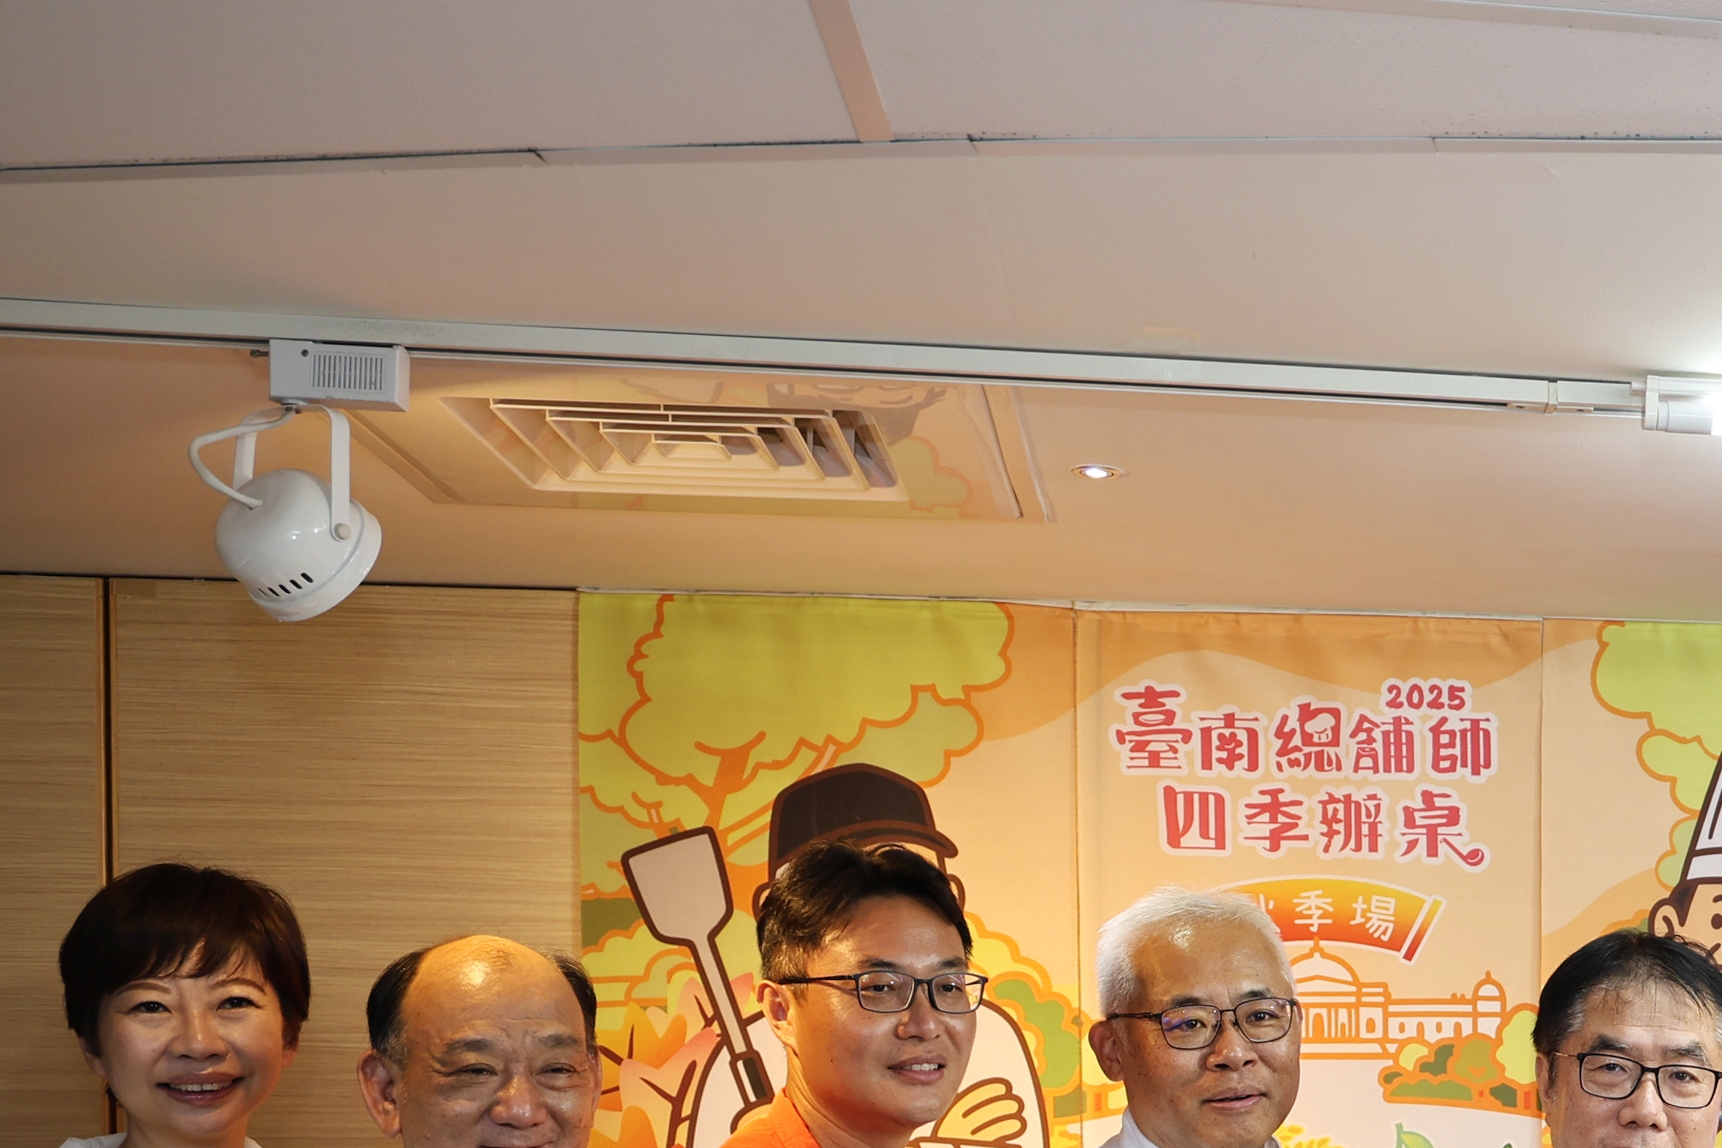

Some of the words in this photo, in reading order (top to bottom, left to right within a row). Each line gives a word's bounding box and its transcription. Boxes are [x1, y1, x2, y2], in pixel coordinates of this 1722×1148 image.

[1385, 683, 1467, 711] 2025
[1163, 785, 1485, 867] 四季辦桌
[1258, 890, 1396, 942] 季場
